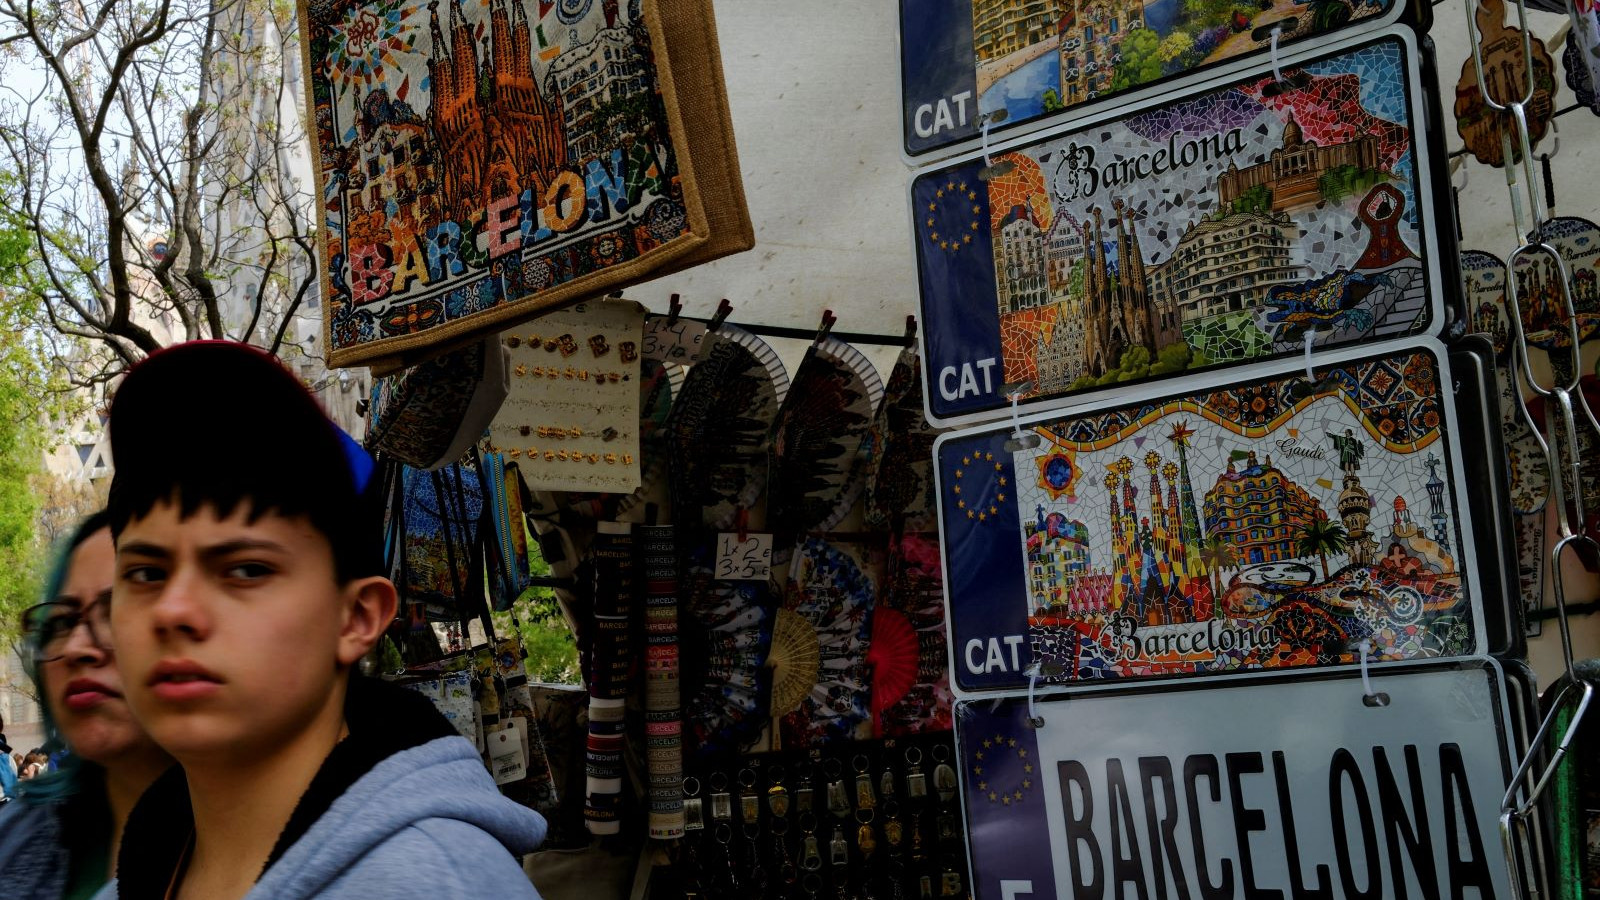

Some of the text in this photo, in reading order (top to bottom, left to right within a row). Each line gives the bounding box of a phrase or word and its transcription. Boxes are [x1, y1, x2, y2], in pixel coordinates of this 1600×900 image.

[914, 91, 971, 138] CAT
[1054, 125, 1248, 203] Barcelona
[348, 138, 668, 304] BARCELONA
[938, 359, 996, 401] CAT
[964, 634, 1024, 675] CAT
[1108, 611, 1283, 664] Barcelona
[1057, 743, 1495, 900] BARCELONA
